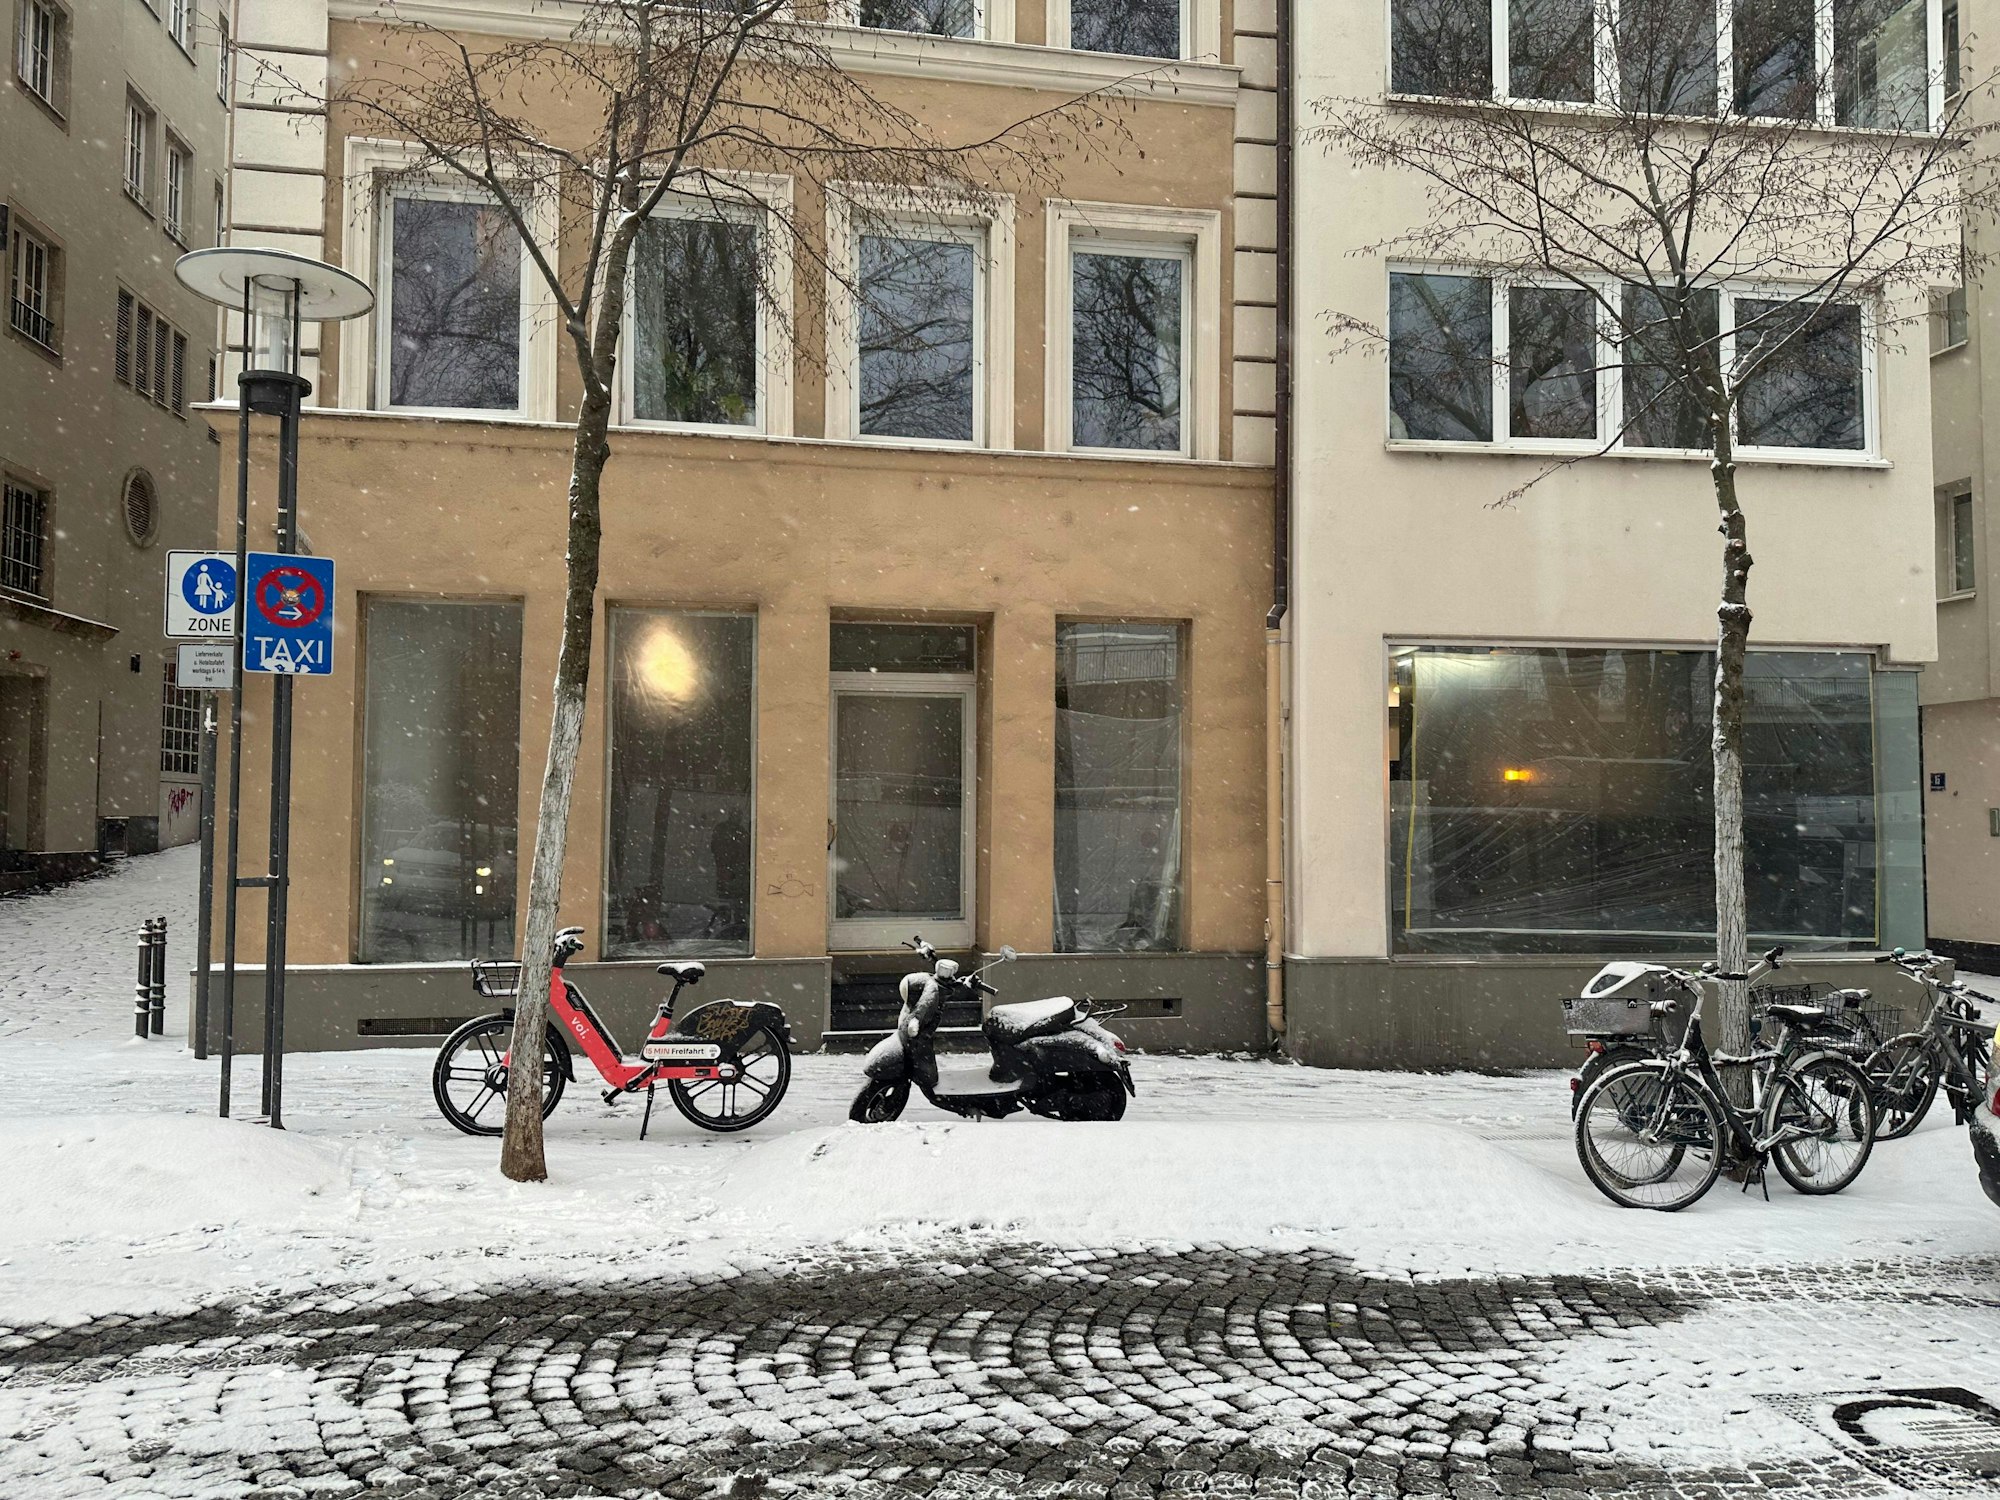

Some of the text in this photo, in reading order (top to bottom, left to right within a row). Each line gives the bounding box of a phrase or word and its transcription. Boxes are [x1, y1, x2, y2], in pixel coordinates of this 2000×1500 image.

[188, 618, 231, 632] ZONE
[254, 636, 324, 664] TAXI
[571, 1016, 590, 1040] voi.
[671, 1047, 704, 1055] Freifahrt
